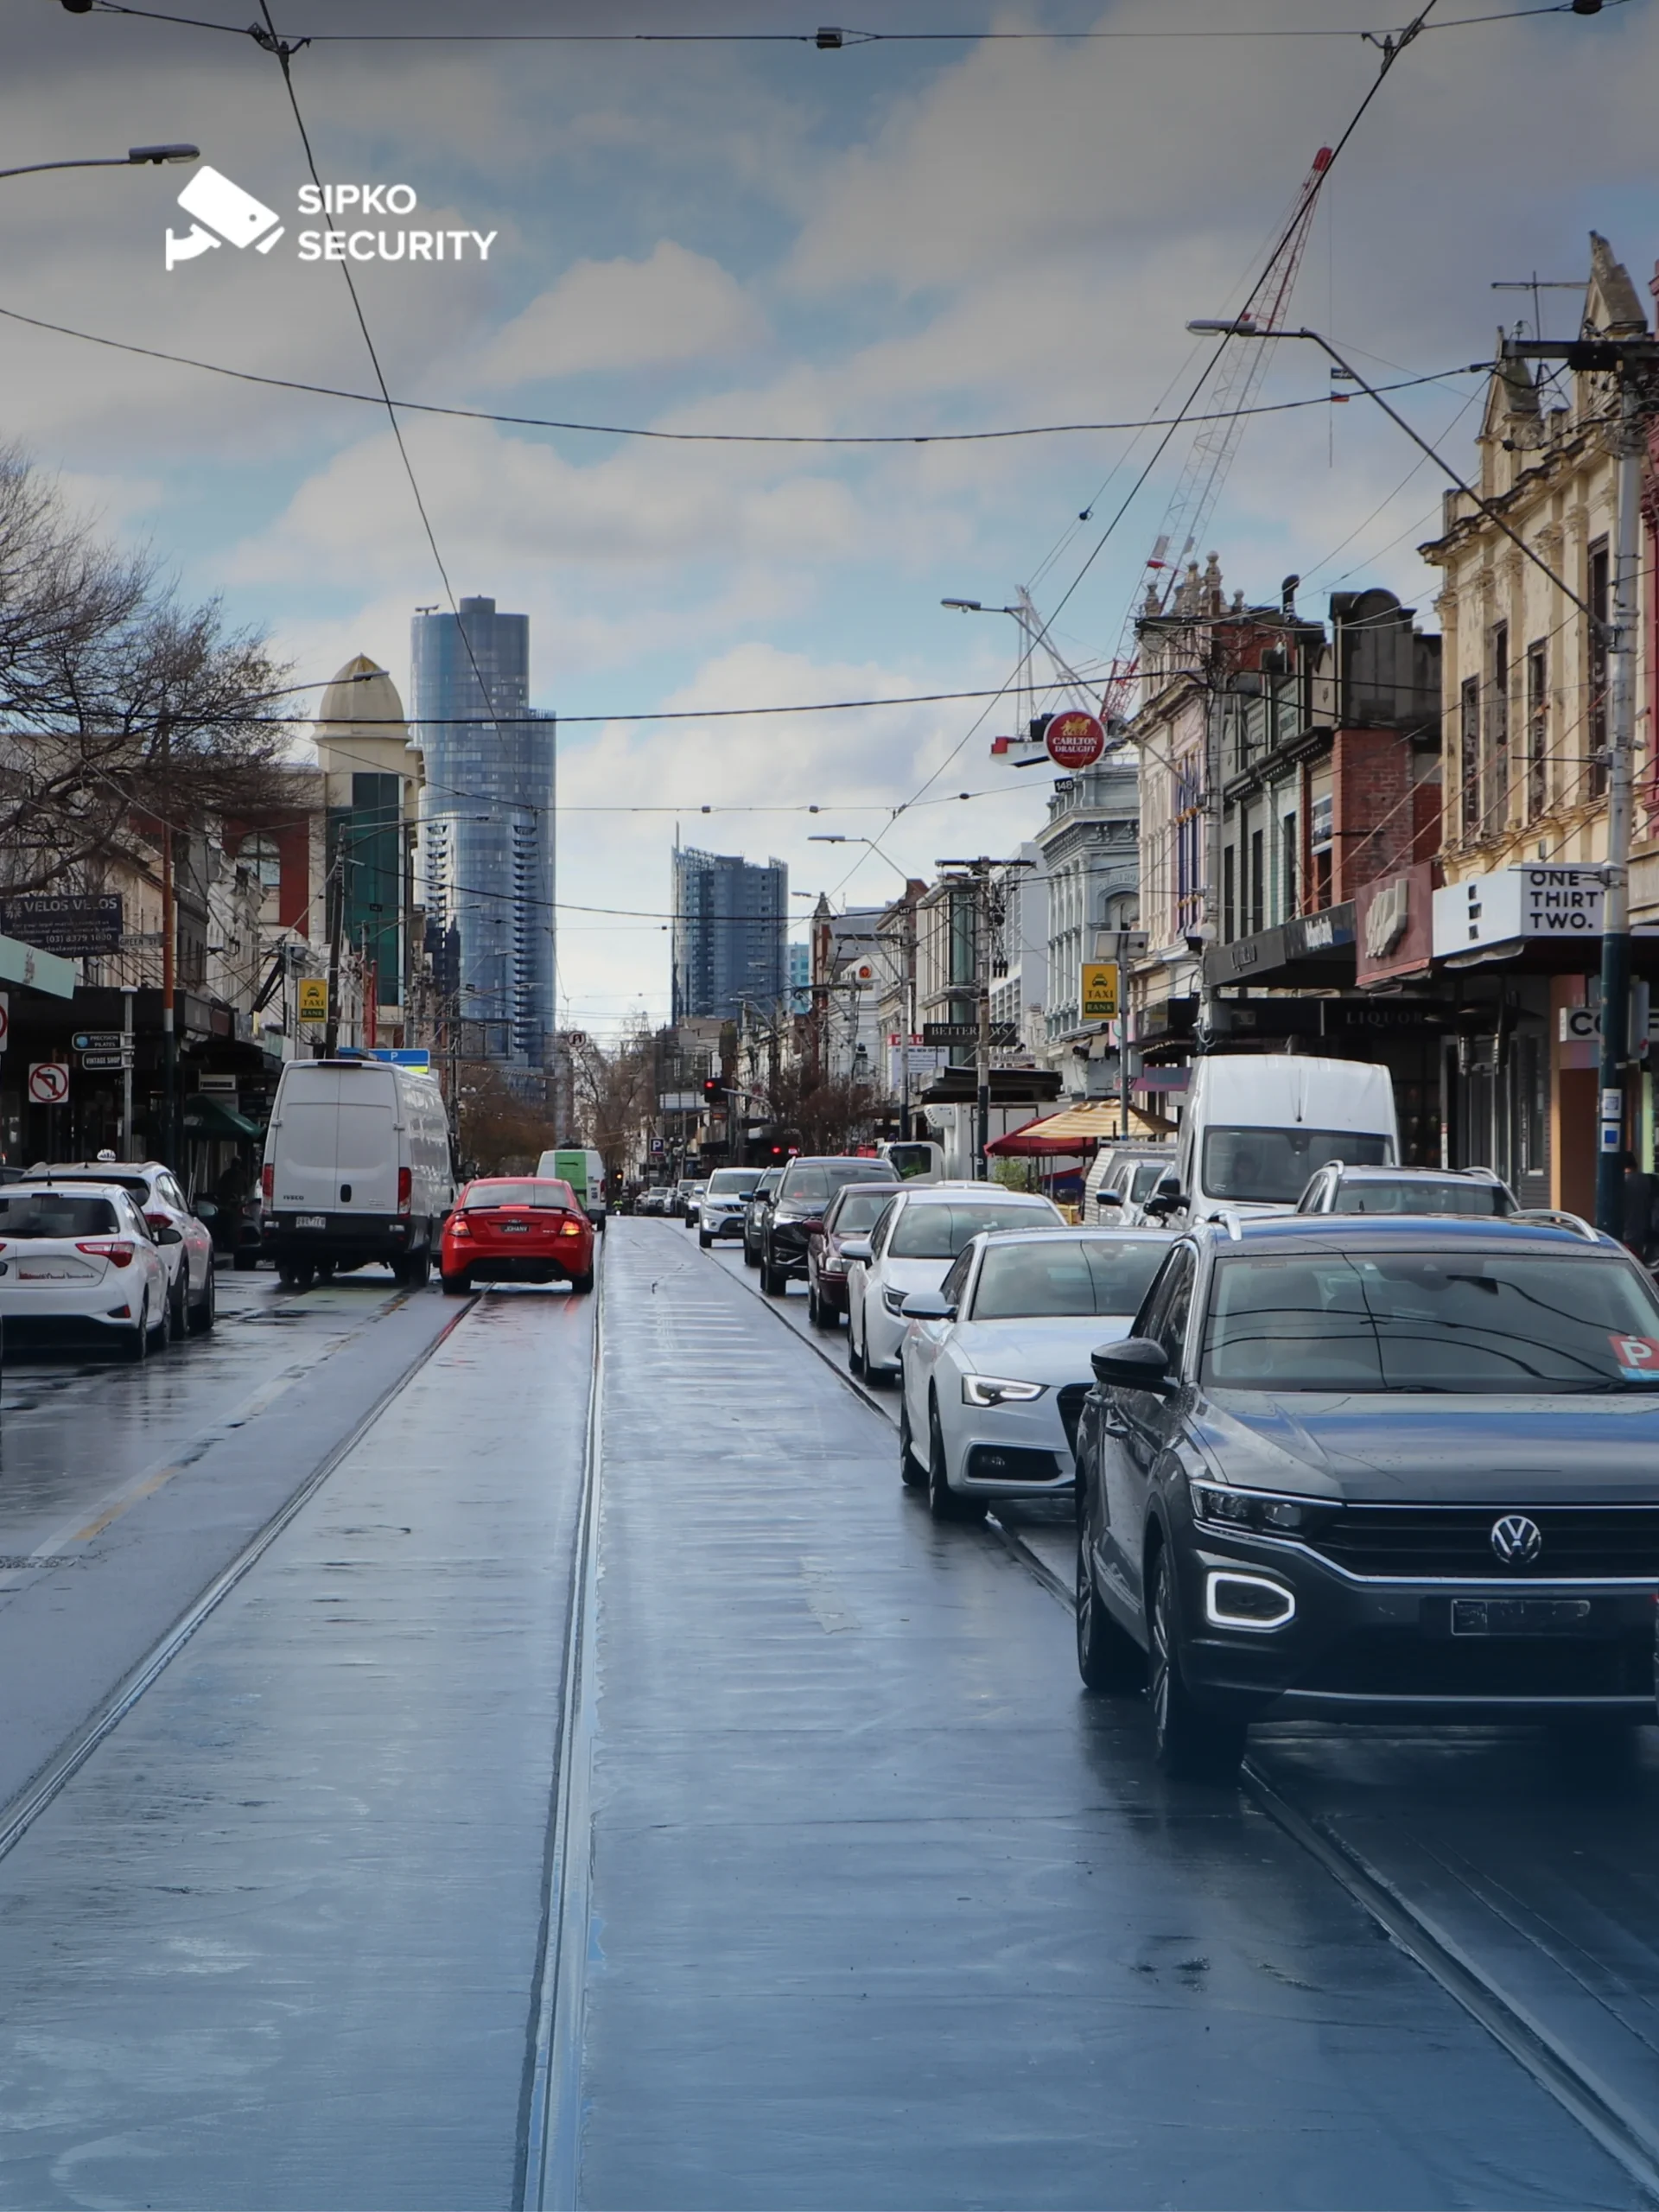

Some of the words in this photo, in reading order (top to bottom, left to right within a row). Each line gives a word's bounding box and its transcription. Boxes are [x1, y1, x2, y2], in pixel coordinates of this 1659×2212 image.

[1052, 736, 1097, 746] CARLTON
[1056, 780, 1073, 790] 148
[1530, 870, 1580, 887] ONE
[1529, 891, 1605, 907] THIRT
[24, 899, 69, 912] VELOS
[73, 898, 118, 910] VEOS
[1529, 912, 1593, 929] TWO.
[119, 938, 143, 946] GREEN
[1087, 989, 1113, 999] TAXI
[1087, 1002, 1113, 1011] RANK
[391, 1052, 398, 1061] P
[652, 1141, 661, 1151] P
[1620, 1340, 1653, 1366] P
